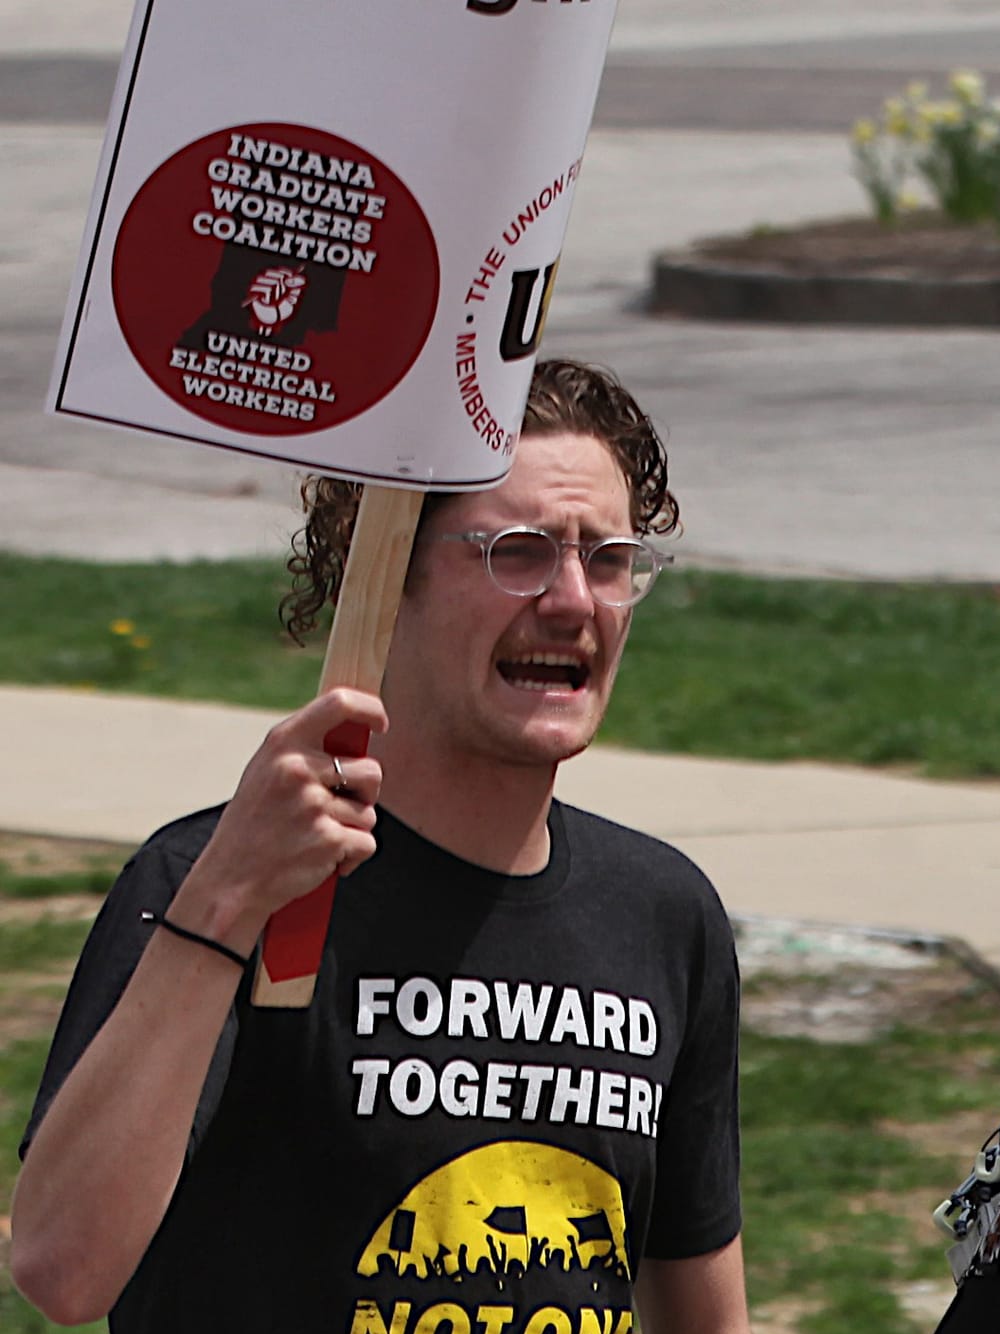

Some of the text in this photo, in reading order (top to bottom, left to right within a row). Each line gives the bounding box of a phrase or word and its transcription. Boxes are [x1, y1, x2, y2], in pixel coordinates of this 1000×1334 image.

[207, 158, 387, 220] GRADUATE
[227, 133, 376, 190] INDIANA
[192, 211, 377, 274] COALITION
[211, 185, 373, 245] WORKERS
[464, 246, 506, 304] THE
[502, 173, 564, 246] UNION
[169, 347, 337, 403] ELECTRICAL
[207, 331, 313, 373] UNITED
[183, 373, 317, 422] WORKERS
[456, 332, 505, 451] MEMBERS
[356, 977, 658, 1057] FORWARD
[352, 1058, 663, 1139] TOGETHER!
